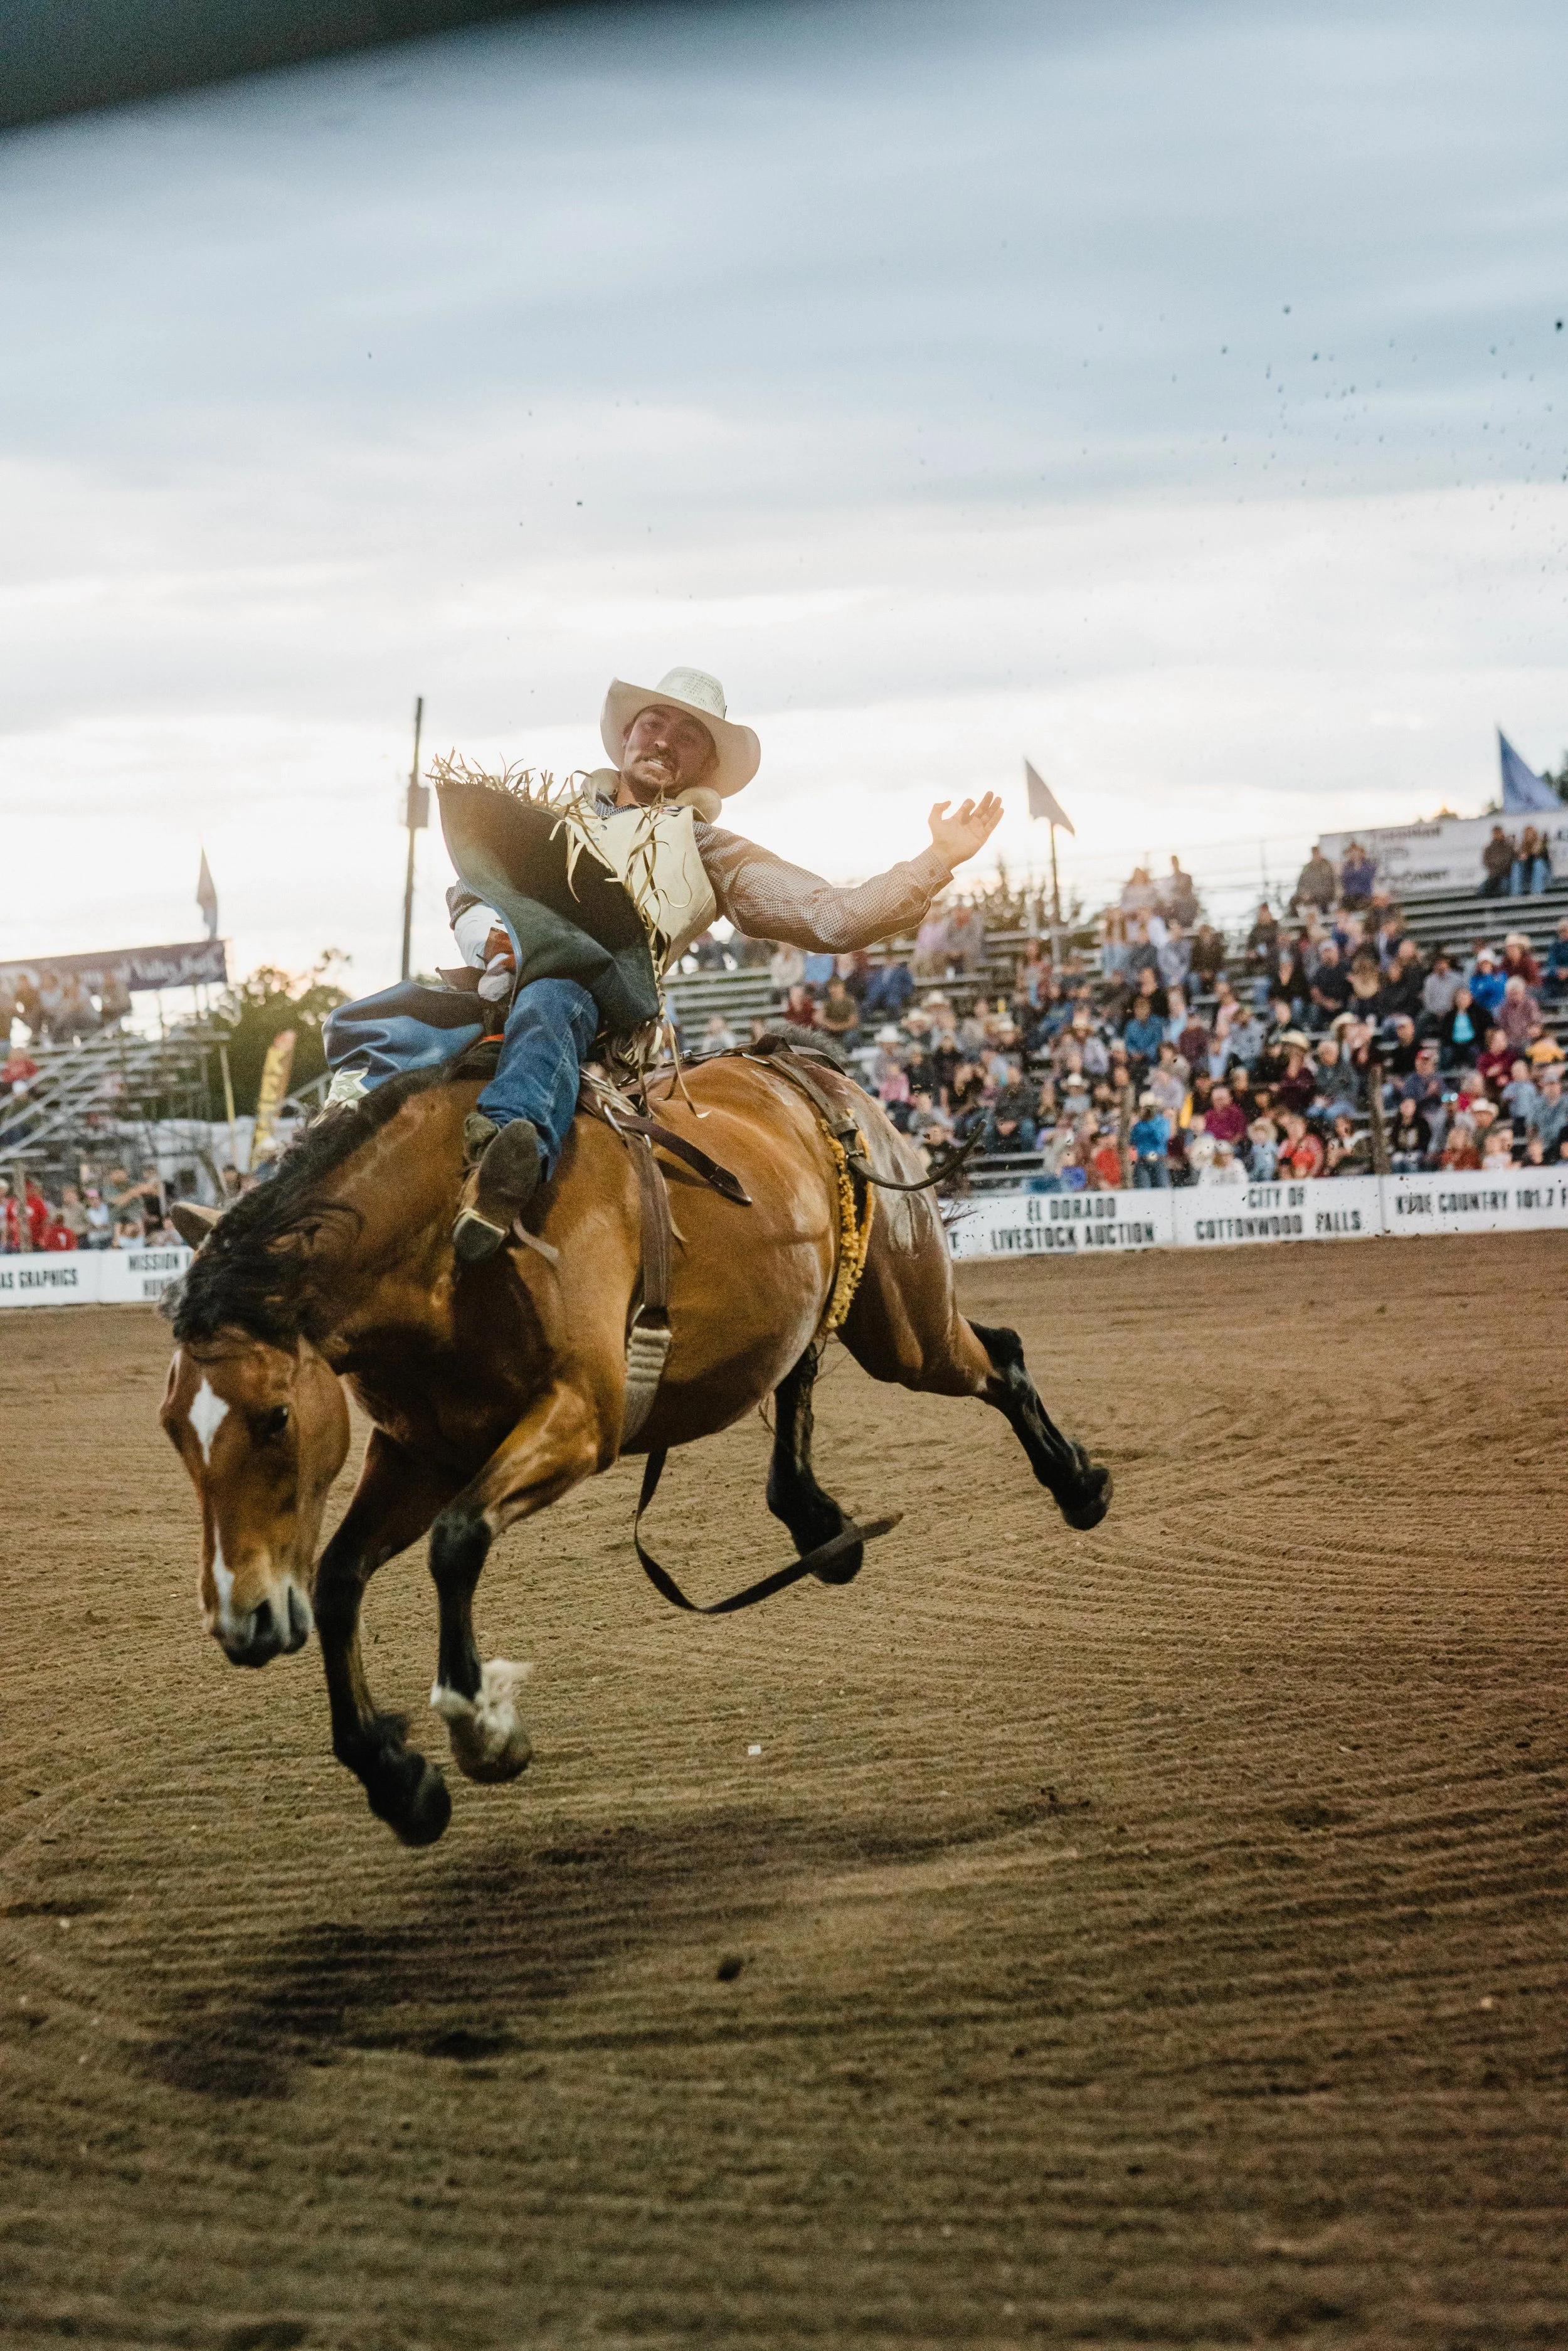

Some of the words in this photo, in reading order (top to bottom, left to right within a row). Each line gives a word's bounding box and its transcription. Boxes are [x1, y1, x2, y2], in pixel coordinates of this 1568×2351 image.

[1249, 1187, 1281, 1208] CITY
[1288, 1186, 1305, 1206] OF
[1439, 1189, 1507, 1212] COUNTRY
[1027, 1199, 1041, 1221] EL
[1050, 1197, 1116, 1221] DORADO
[990, 1226, 1076, 1251] LIVESTOCK
[1084, 1222, 1155, 1246] AUCTION
[1195, 1214, 1303, 1240] COTTONWOOD
[1316, 1210, 1361, 1232] FALLS
[19, 1268, 78, 1288] GRAPHICS
